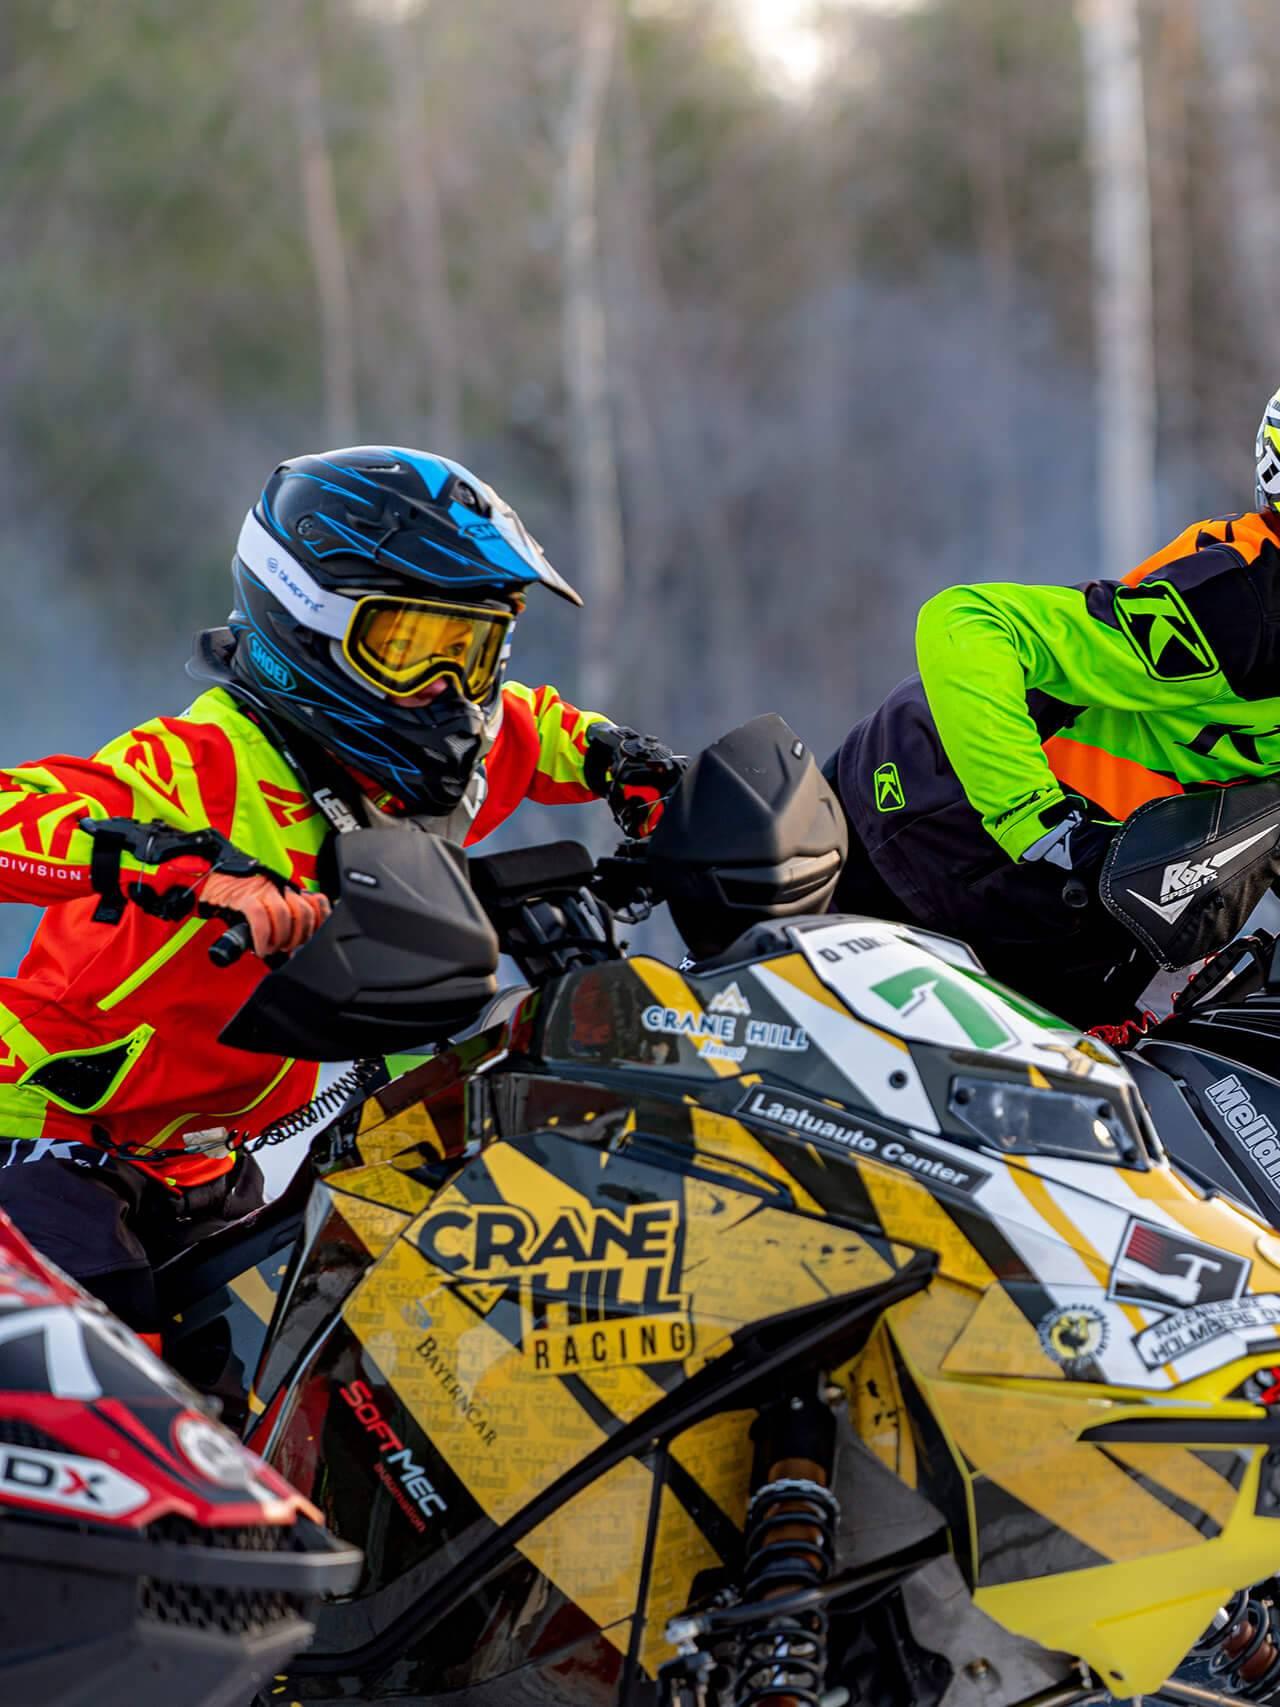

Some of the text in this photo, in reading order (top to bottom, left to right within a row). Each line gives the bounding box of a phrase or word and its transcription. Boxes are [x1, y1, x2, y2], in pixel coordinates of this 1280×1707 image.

[250, 637, 289, 687] SHOEI
[0, 856, 81, 881] DIVISION
[642, 1005, 810, 1051] CRANE HILL
[749, 1092, 970, 1185] Laatuauto Center
[417, 1204, 675, 1275] CRANE
[530, 1266, 682, 1332] HILL
[535, 1322, 686, 1370] RACING
[416, 1335, 497, 1447] BAYERNCAR
